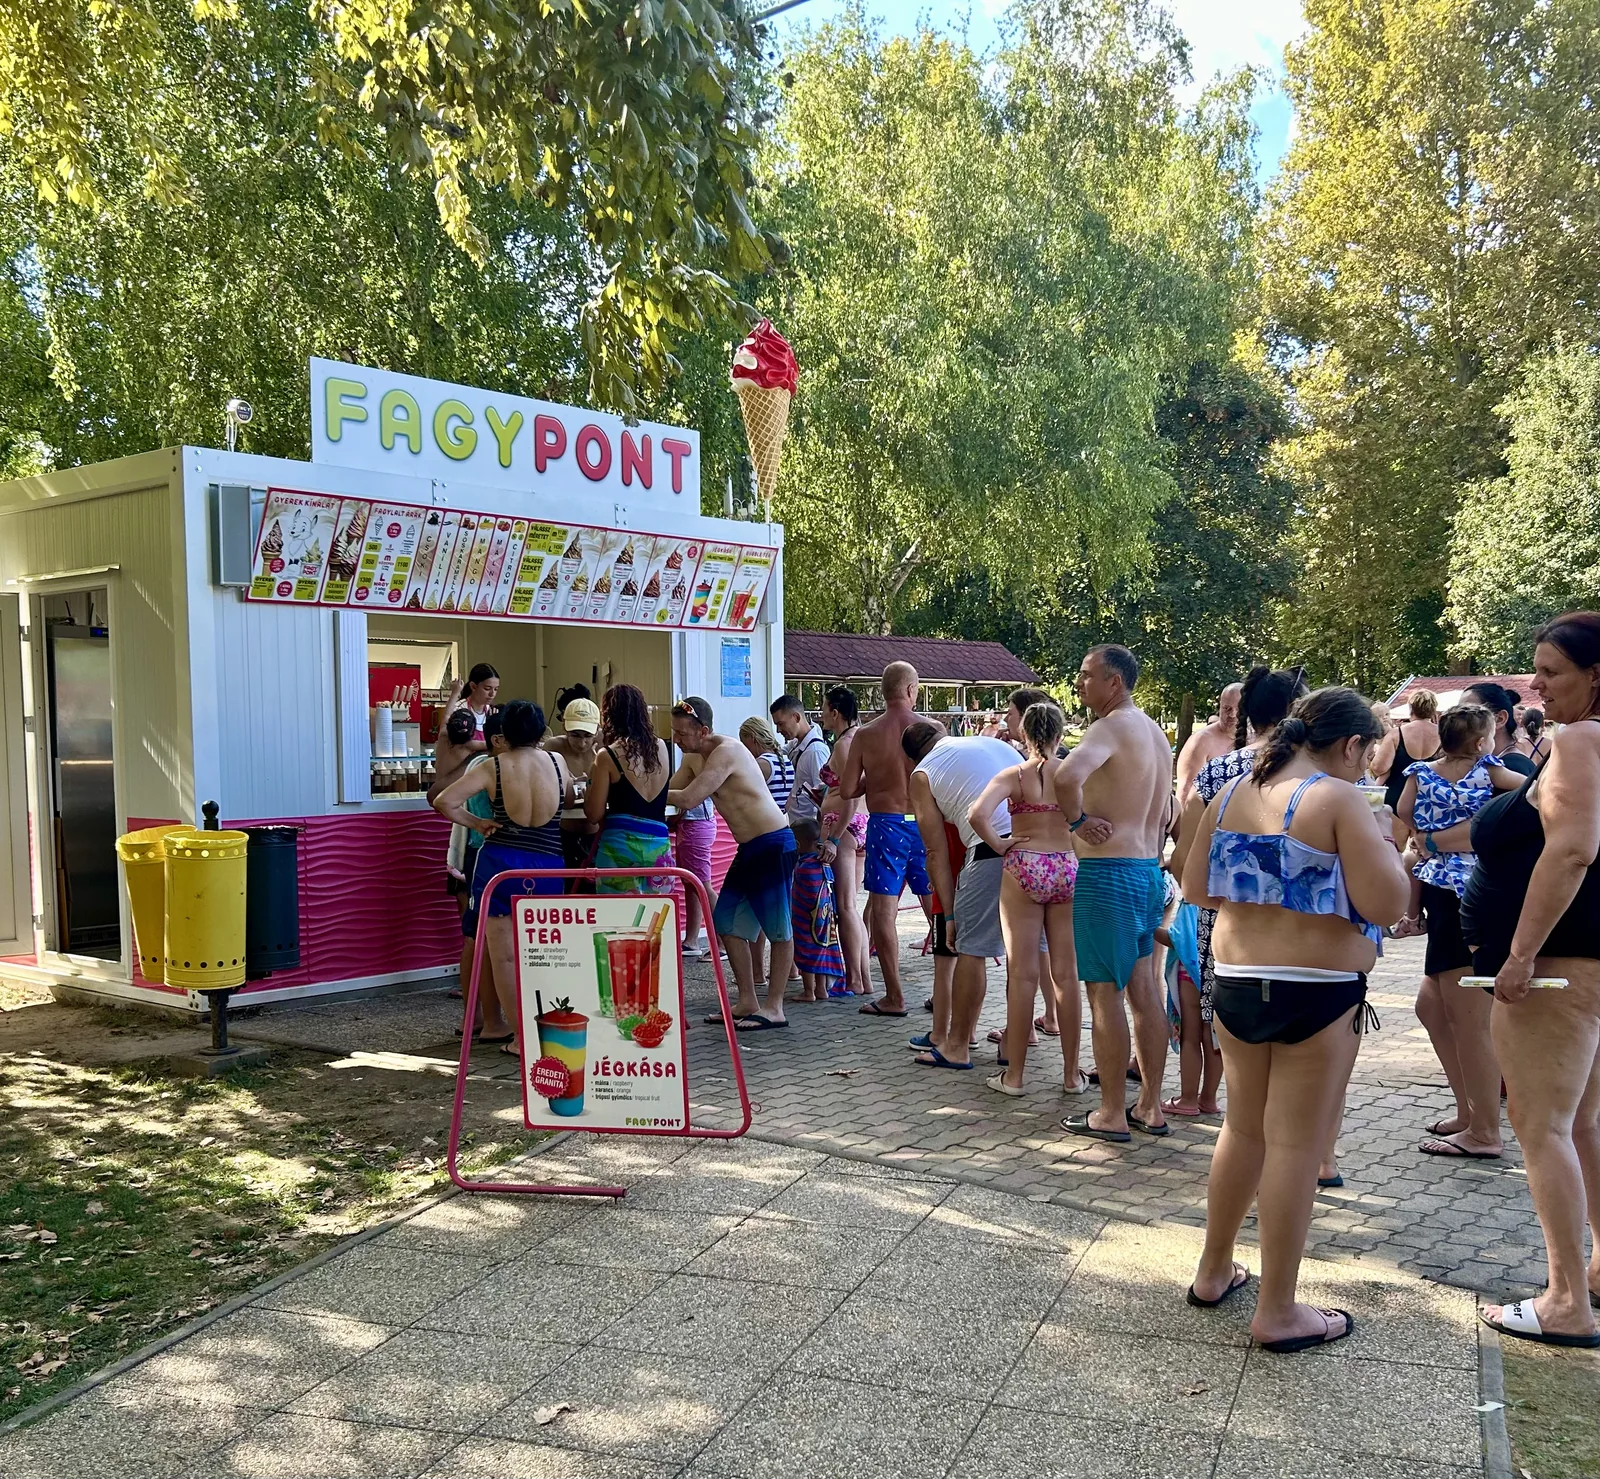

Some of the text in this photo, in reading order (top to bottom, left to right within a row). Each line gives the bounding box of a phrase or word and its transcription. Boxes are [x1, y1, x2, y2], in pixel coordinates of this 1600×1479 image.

[324, 377, 692, 494] FAGYPONT
[503, 543, 518, 585] CITROM
[380, 573, 386, 582] L
[523, 908, 597, 925] BUBBLE
[525, 928, 562, 944] TEA
[536, 1067, 565, 1080] EREDETI
[592, 1055, 677, 1078] JÉGKÁSA
[535, 1076, 564, 1089] GRANITA
[613, 1080, 634, 1088] raspberry
[625, 1116, 682, 1127] FAGYPONT
